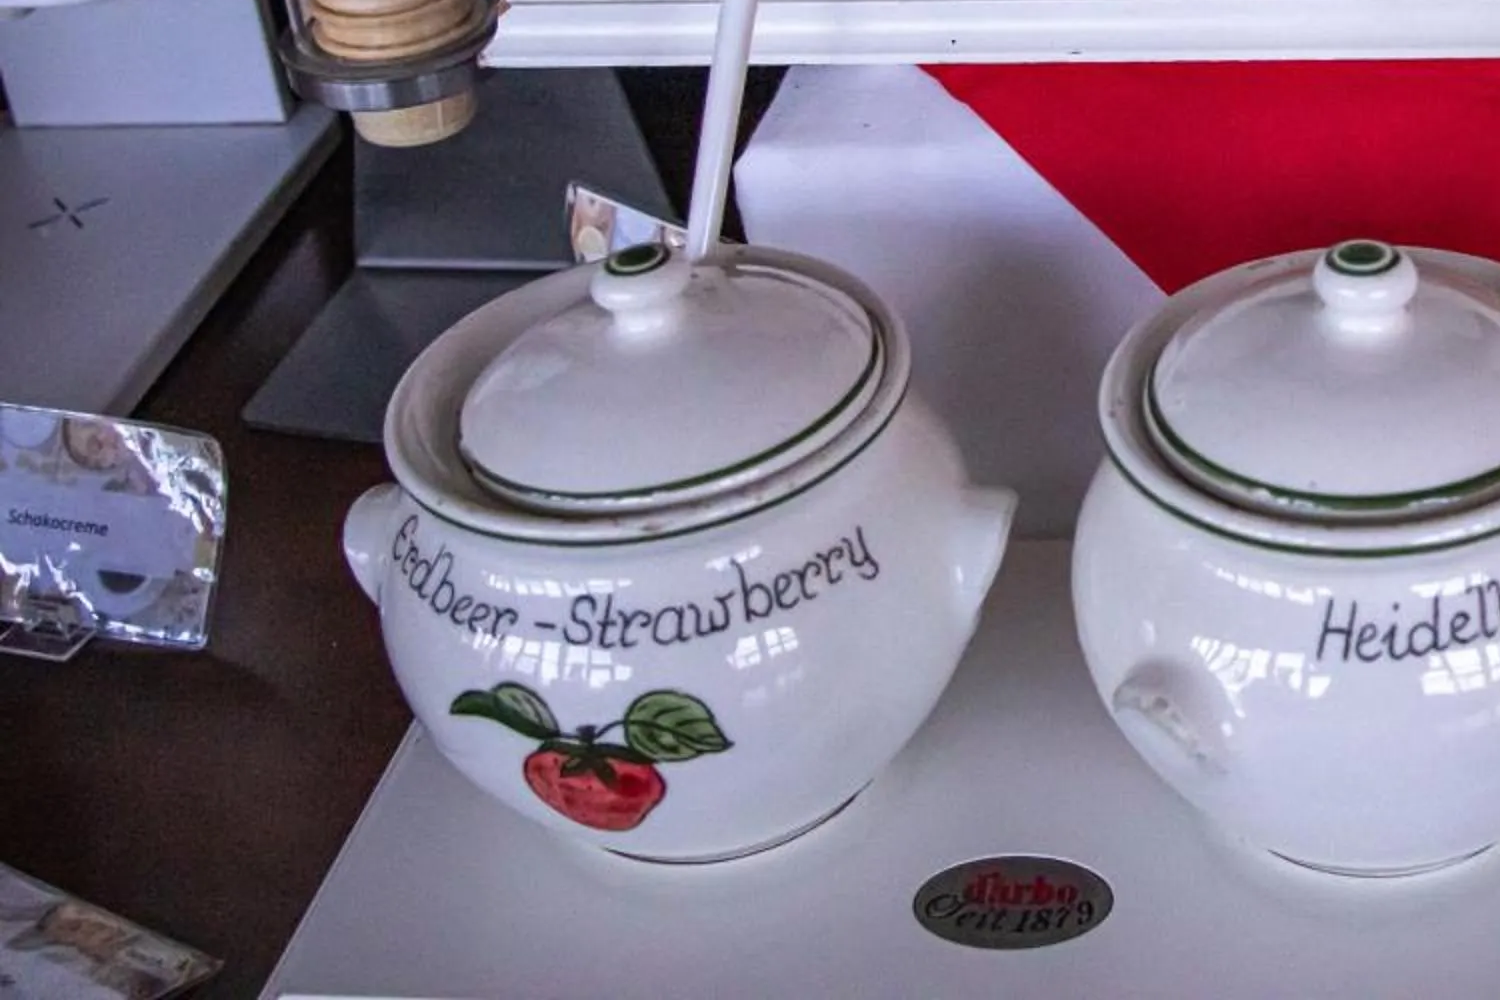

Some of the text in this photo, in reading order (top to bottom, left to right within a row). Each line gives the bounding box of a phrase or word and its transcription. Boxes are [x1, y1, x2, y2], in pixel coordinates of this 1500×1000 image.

[7, 508, 110, 538] Schokocreme
[392, 514, 520, 639] Erdbeer
[562, 525, 881, 650] Strawberry
[1011, 900, 1095, 934] 1879
